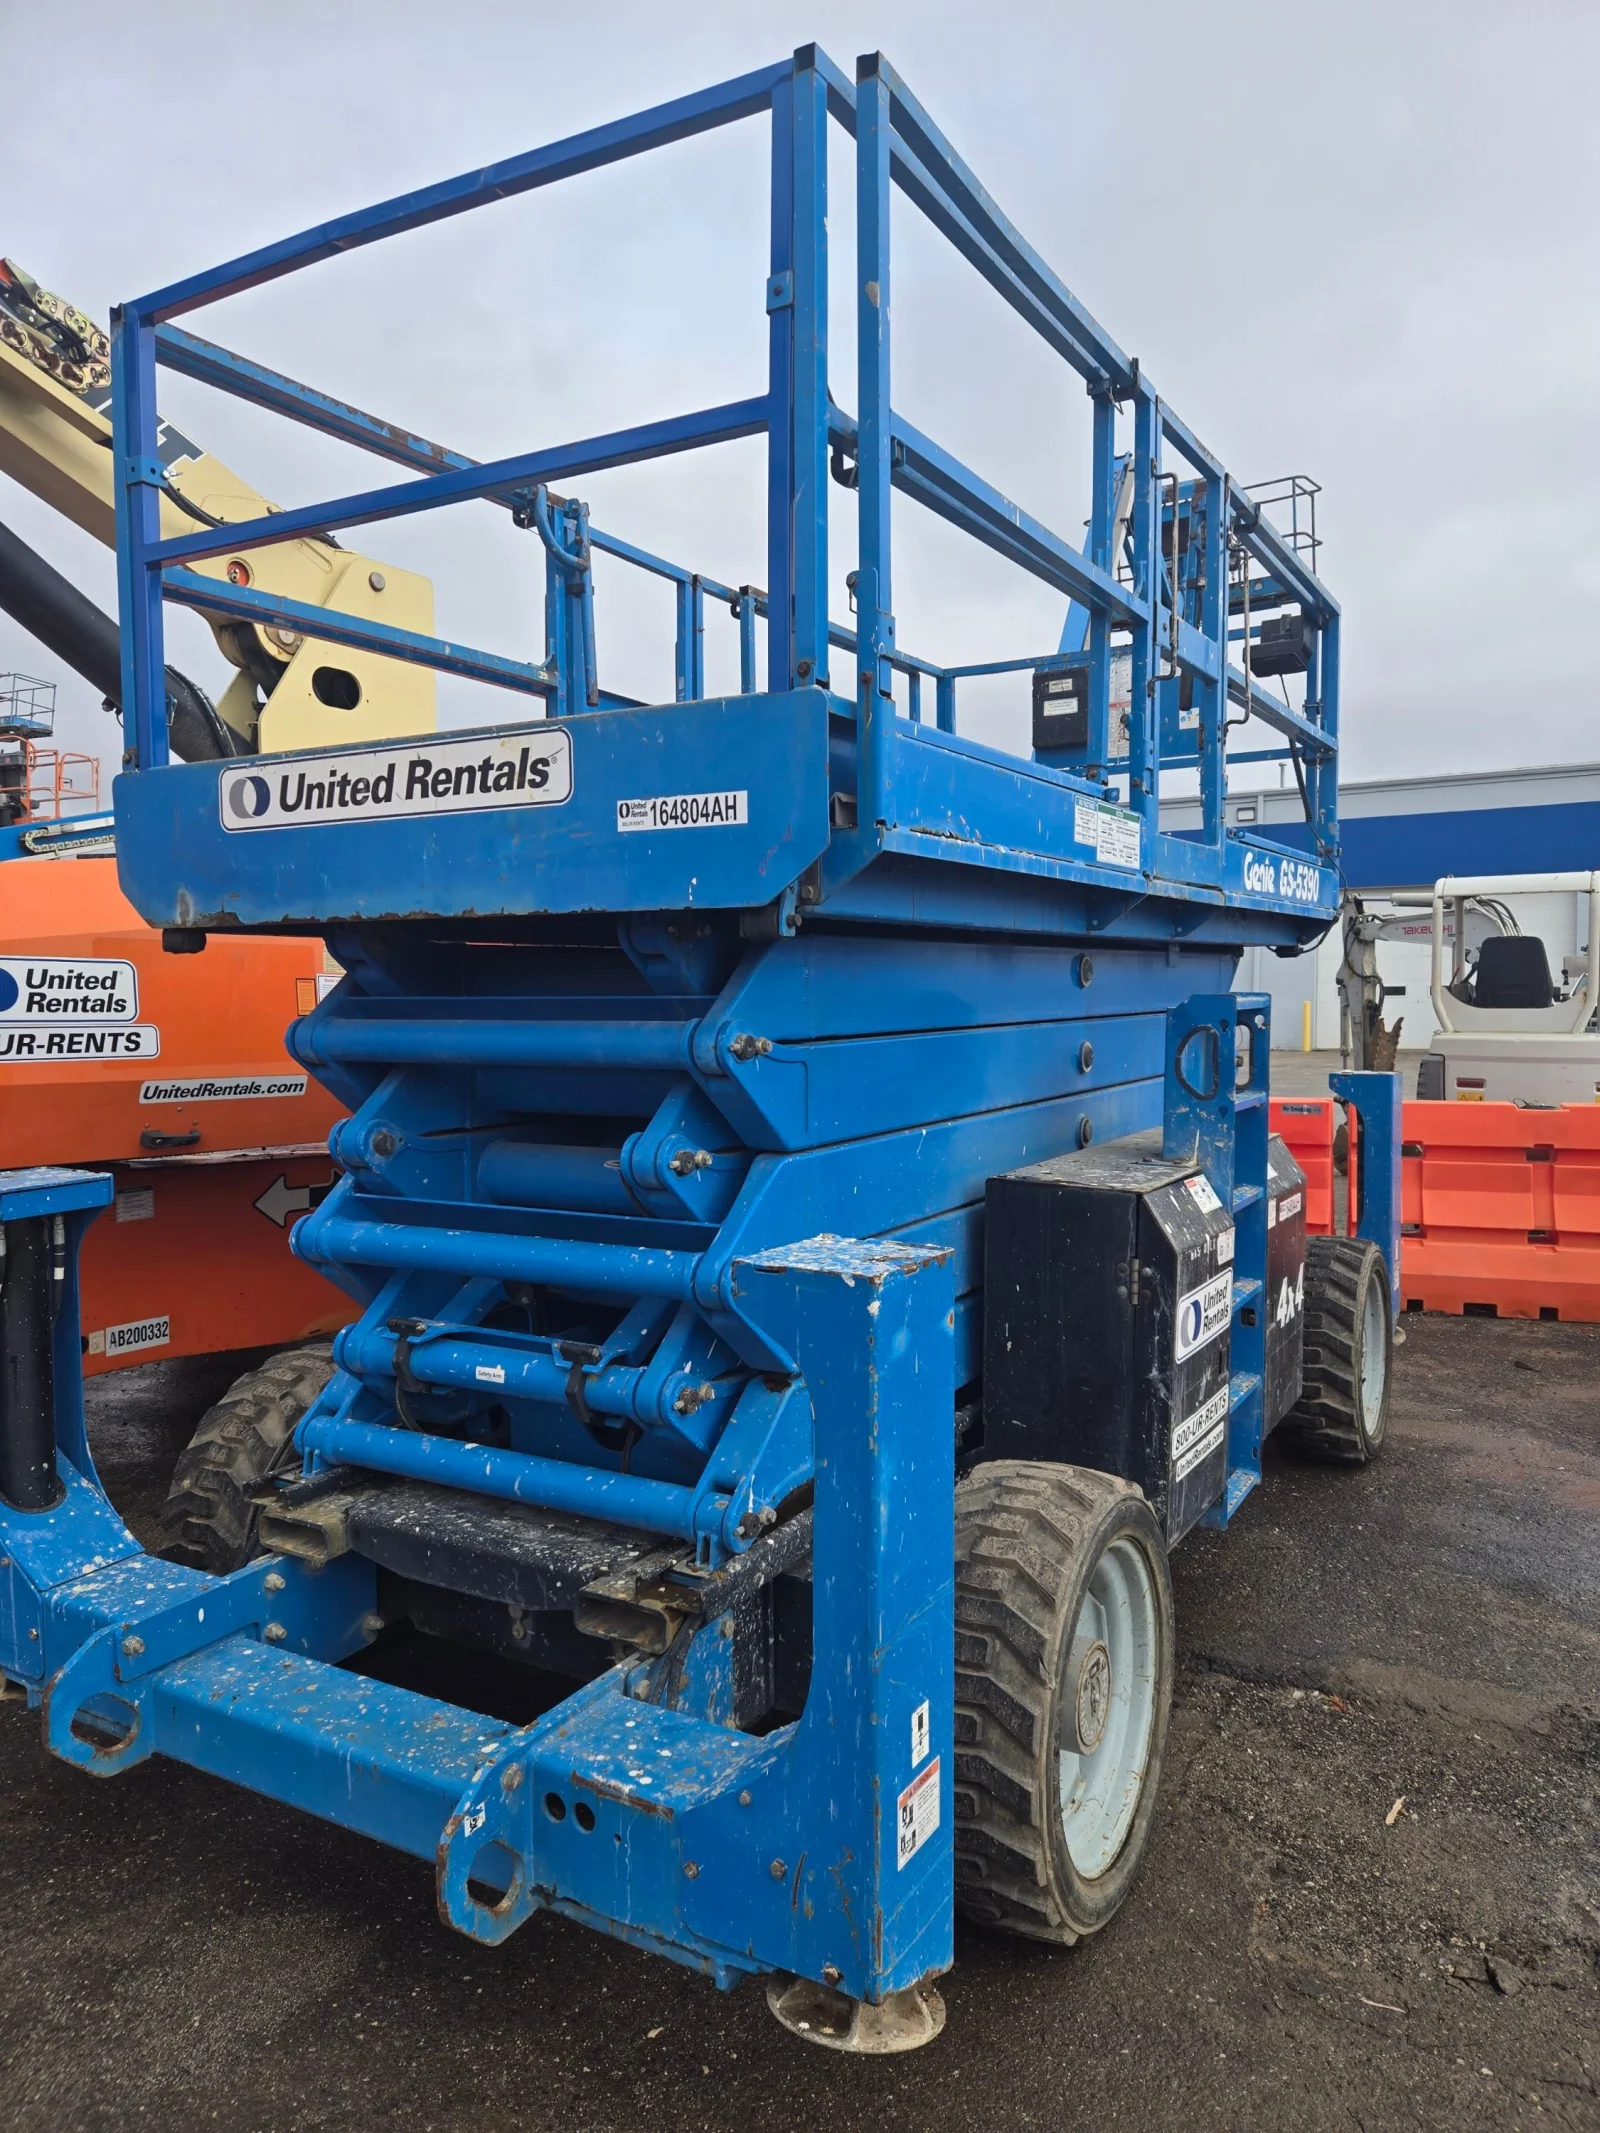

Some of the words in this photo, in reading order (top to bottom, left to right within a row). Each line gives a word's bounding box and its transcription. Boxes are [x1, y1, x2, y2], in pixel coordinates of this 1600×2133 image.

[279, 763, 396, 813] United
[404, 747, 551, 801] Rentals
[630, 801, 647, 809] United
[630, 810, 649, 818] Rentals
[650, 794, 737, 826] 164804AH
[1244, 852, 1275, 894] Genie
[1280, 859, 1319, 902] GS-5390
[26, 968, 118, 990] United
[26, 992, 128, 1013] Rentals
[143, 1081, 305, 1100] UnitedRentals.com
[1203, 1279, 1229, 1313] United
[1276, 1262, 1305, 1328] 4x4
[109, 1321, 169, 1348] AB200332
[1202, 1303, 1229, 1337] Rentals
[1175, 1392, 1226, 1451] 800-UR-RENTS
[1177, 1429, 1223, 1478] UnitedRentals.com
